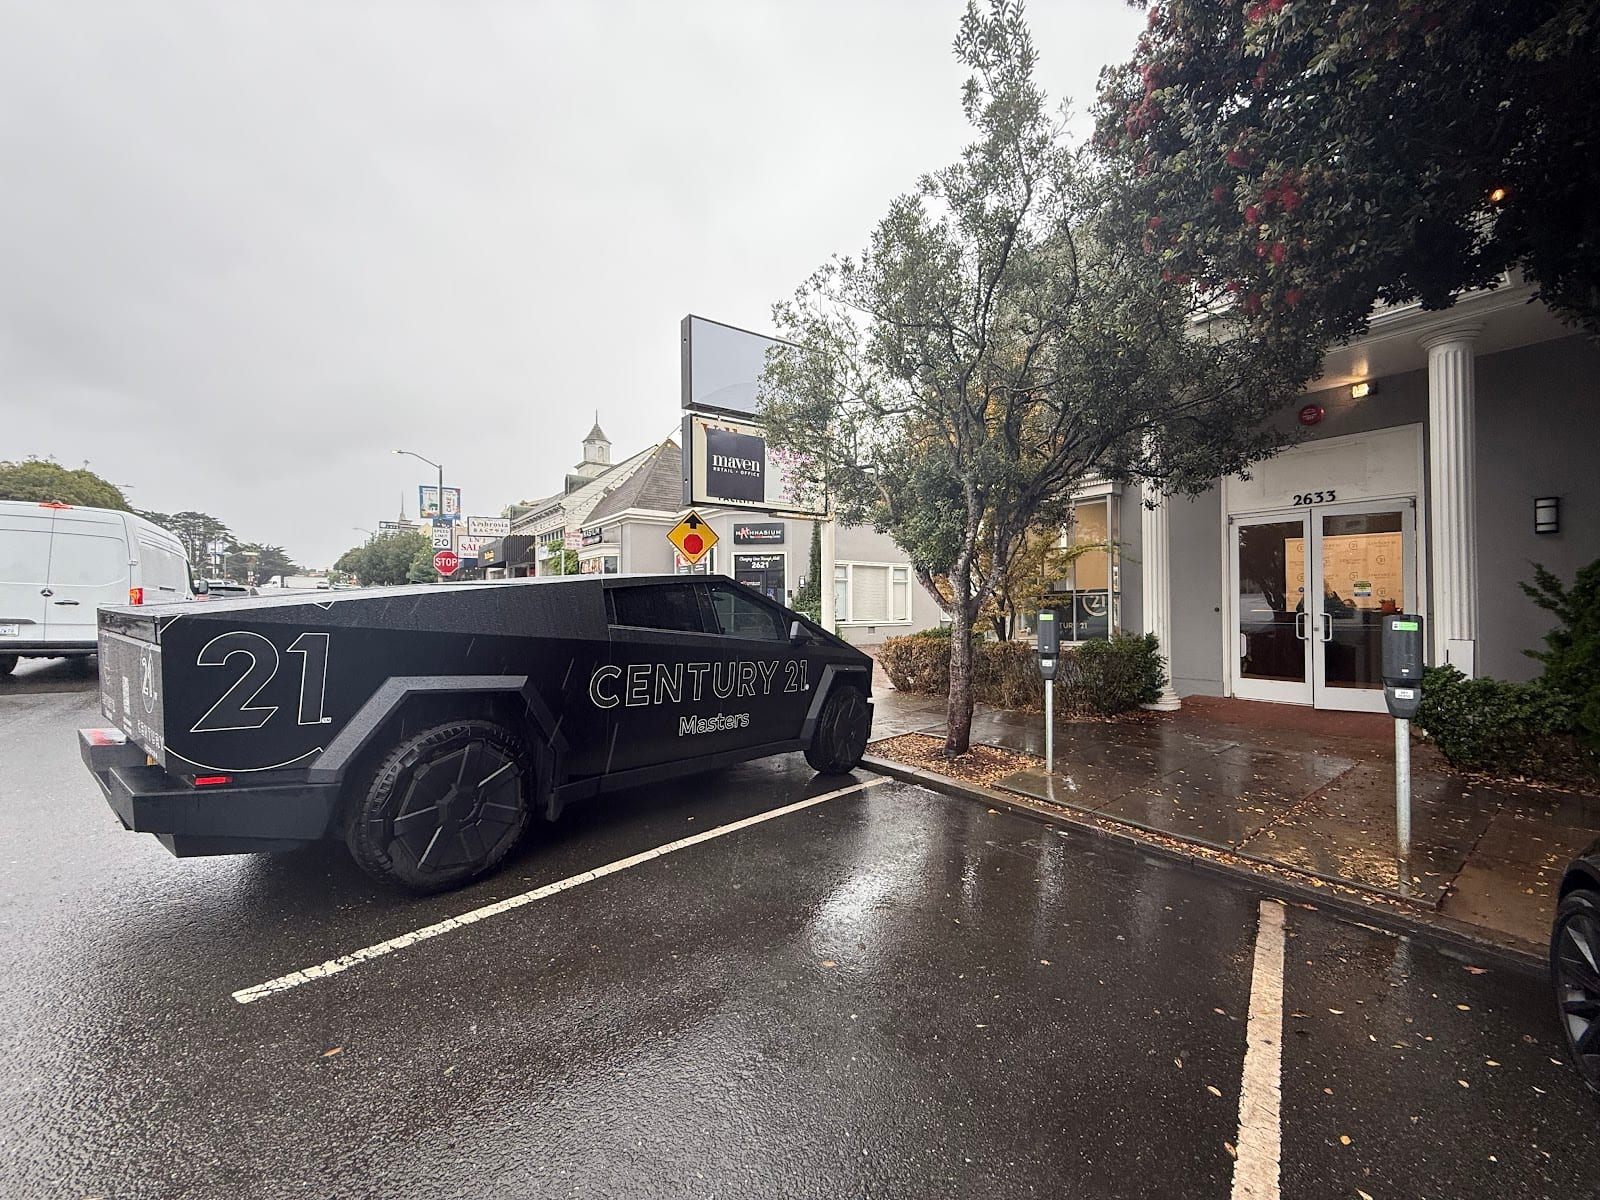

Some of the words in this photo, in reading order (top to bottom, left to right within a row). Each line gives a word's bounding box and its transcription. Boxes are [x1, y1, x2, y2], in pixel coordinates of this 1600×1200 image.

[712, 454, 760, 473] maven
[713, 466, 733, 474] RETAIL
[740, 470, 760, 478] OFFICE
[1293, 490, 1336, 506] 2633
[434, 539, 449, 547] 20
[435, 557, 457, 567] STOP
[751, 561, 769, 569] 2621
[190, 631, 330, 733] 21
[589, 660, 779, 708] CENTURY
[783, 659, 809, 693] 21
[678, 712, 750, 736] Masters
